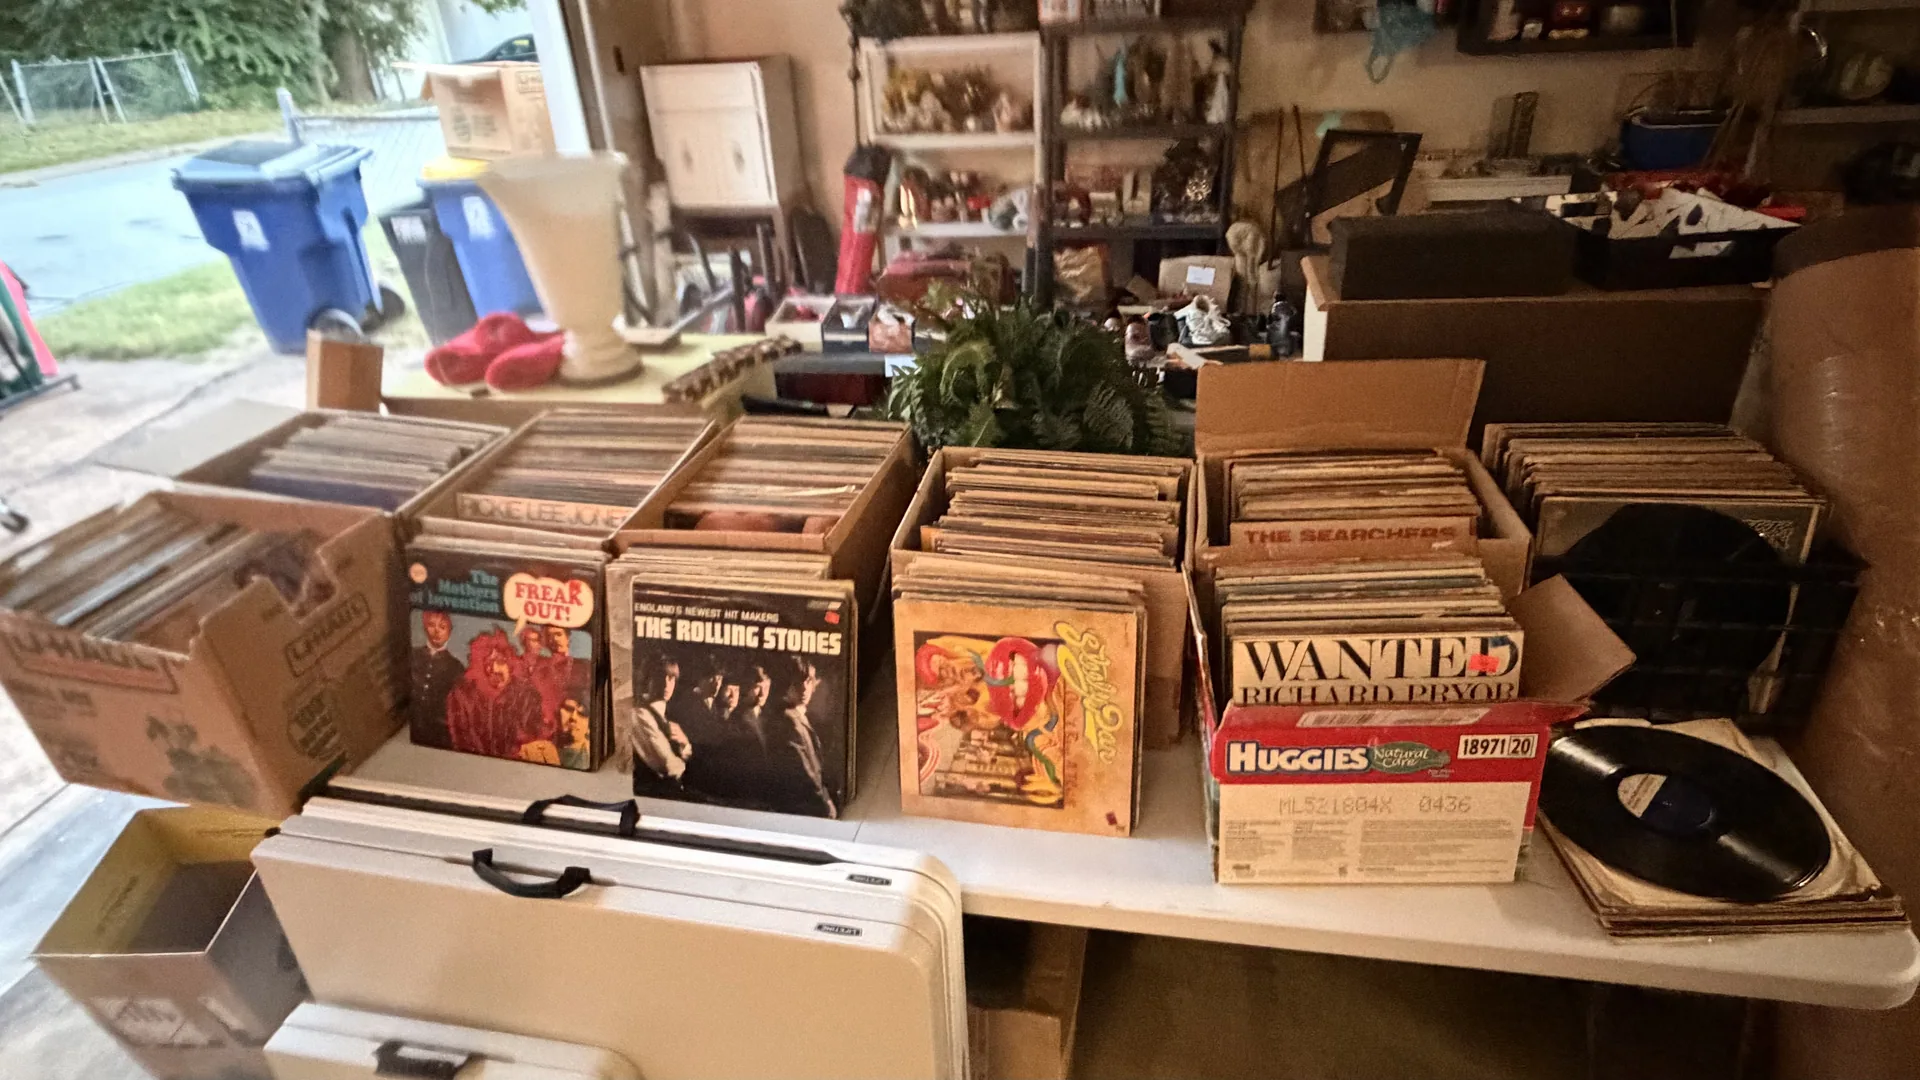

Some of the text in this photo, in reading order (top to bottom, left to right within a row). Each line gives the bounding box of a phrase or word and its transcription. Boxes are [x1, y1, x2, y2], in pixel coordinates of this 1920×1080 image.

[527, 503, 566, 523] LEE
[1244, 526, 1457, 544] THE SEARCHERS
[470, 570, 498, 586] The
[439, 580, 499, 598] Mothers
[515, 580, 583, 606] FREAK
[428, 590, 499, 613] Invention
[523, 601, 571, 621] OUT!
[634, 602, 779, 624] ENGLAND'S NEWEST HIT MAKERS
[634, 616, 842, 656] THE ROLLING STONES
[1242, 635, 1520, 681] WANTED
[1239, 681, 1519, 704] RICHARD PRYOR
[1374, 747, 1430, 760] Natural
[1462, 737, 1532, 756] 18971 20
[1228, 741, 1370, 773] HUGGIES
[1382, 758, 1418, 769] Care
[1418, 796, 1471, 813] 0436
